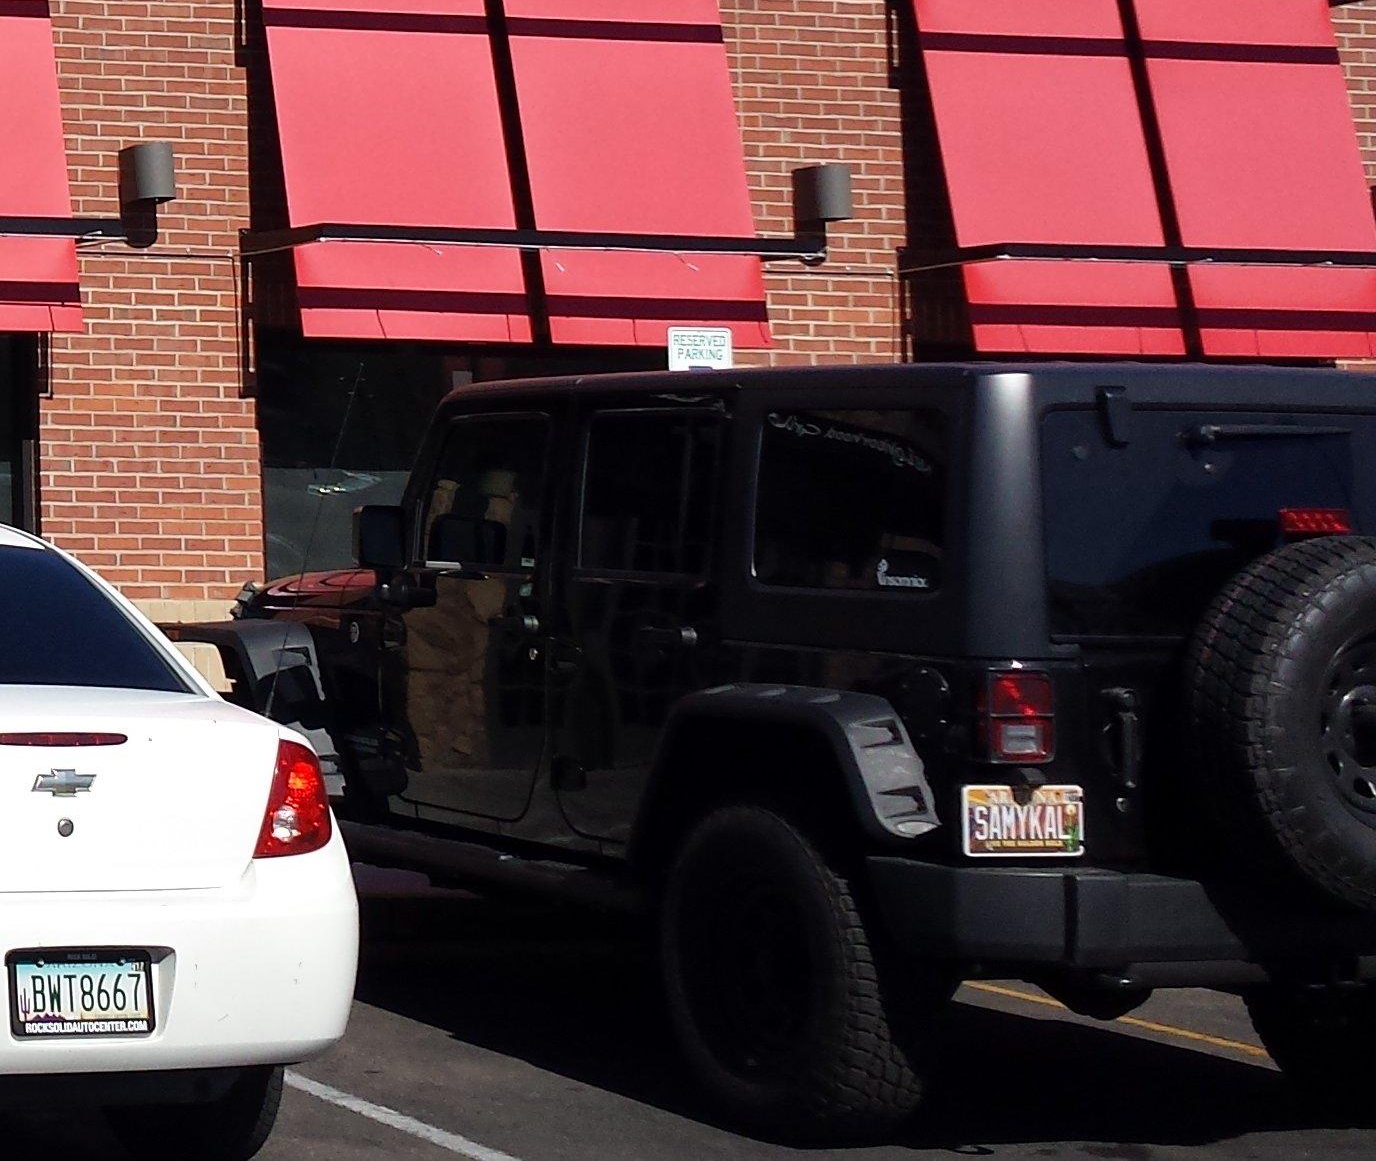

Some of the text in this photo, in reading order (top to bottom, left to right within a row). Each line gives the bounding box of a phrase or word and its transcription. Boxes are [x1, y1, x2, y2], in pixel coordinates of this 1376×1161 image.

[673, 334, 726, 347] RESERVED
[677, 348, 723, 361] PARKING
[974, 804, 1072, 840] SAMYKAL
[31, 973, 141, 1013] BWT8667
[25, 1020, 148, 1034] ROCKSOLIDAUTOCENTER.COM
